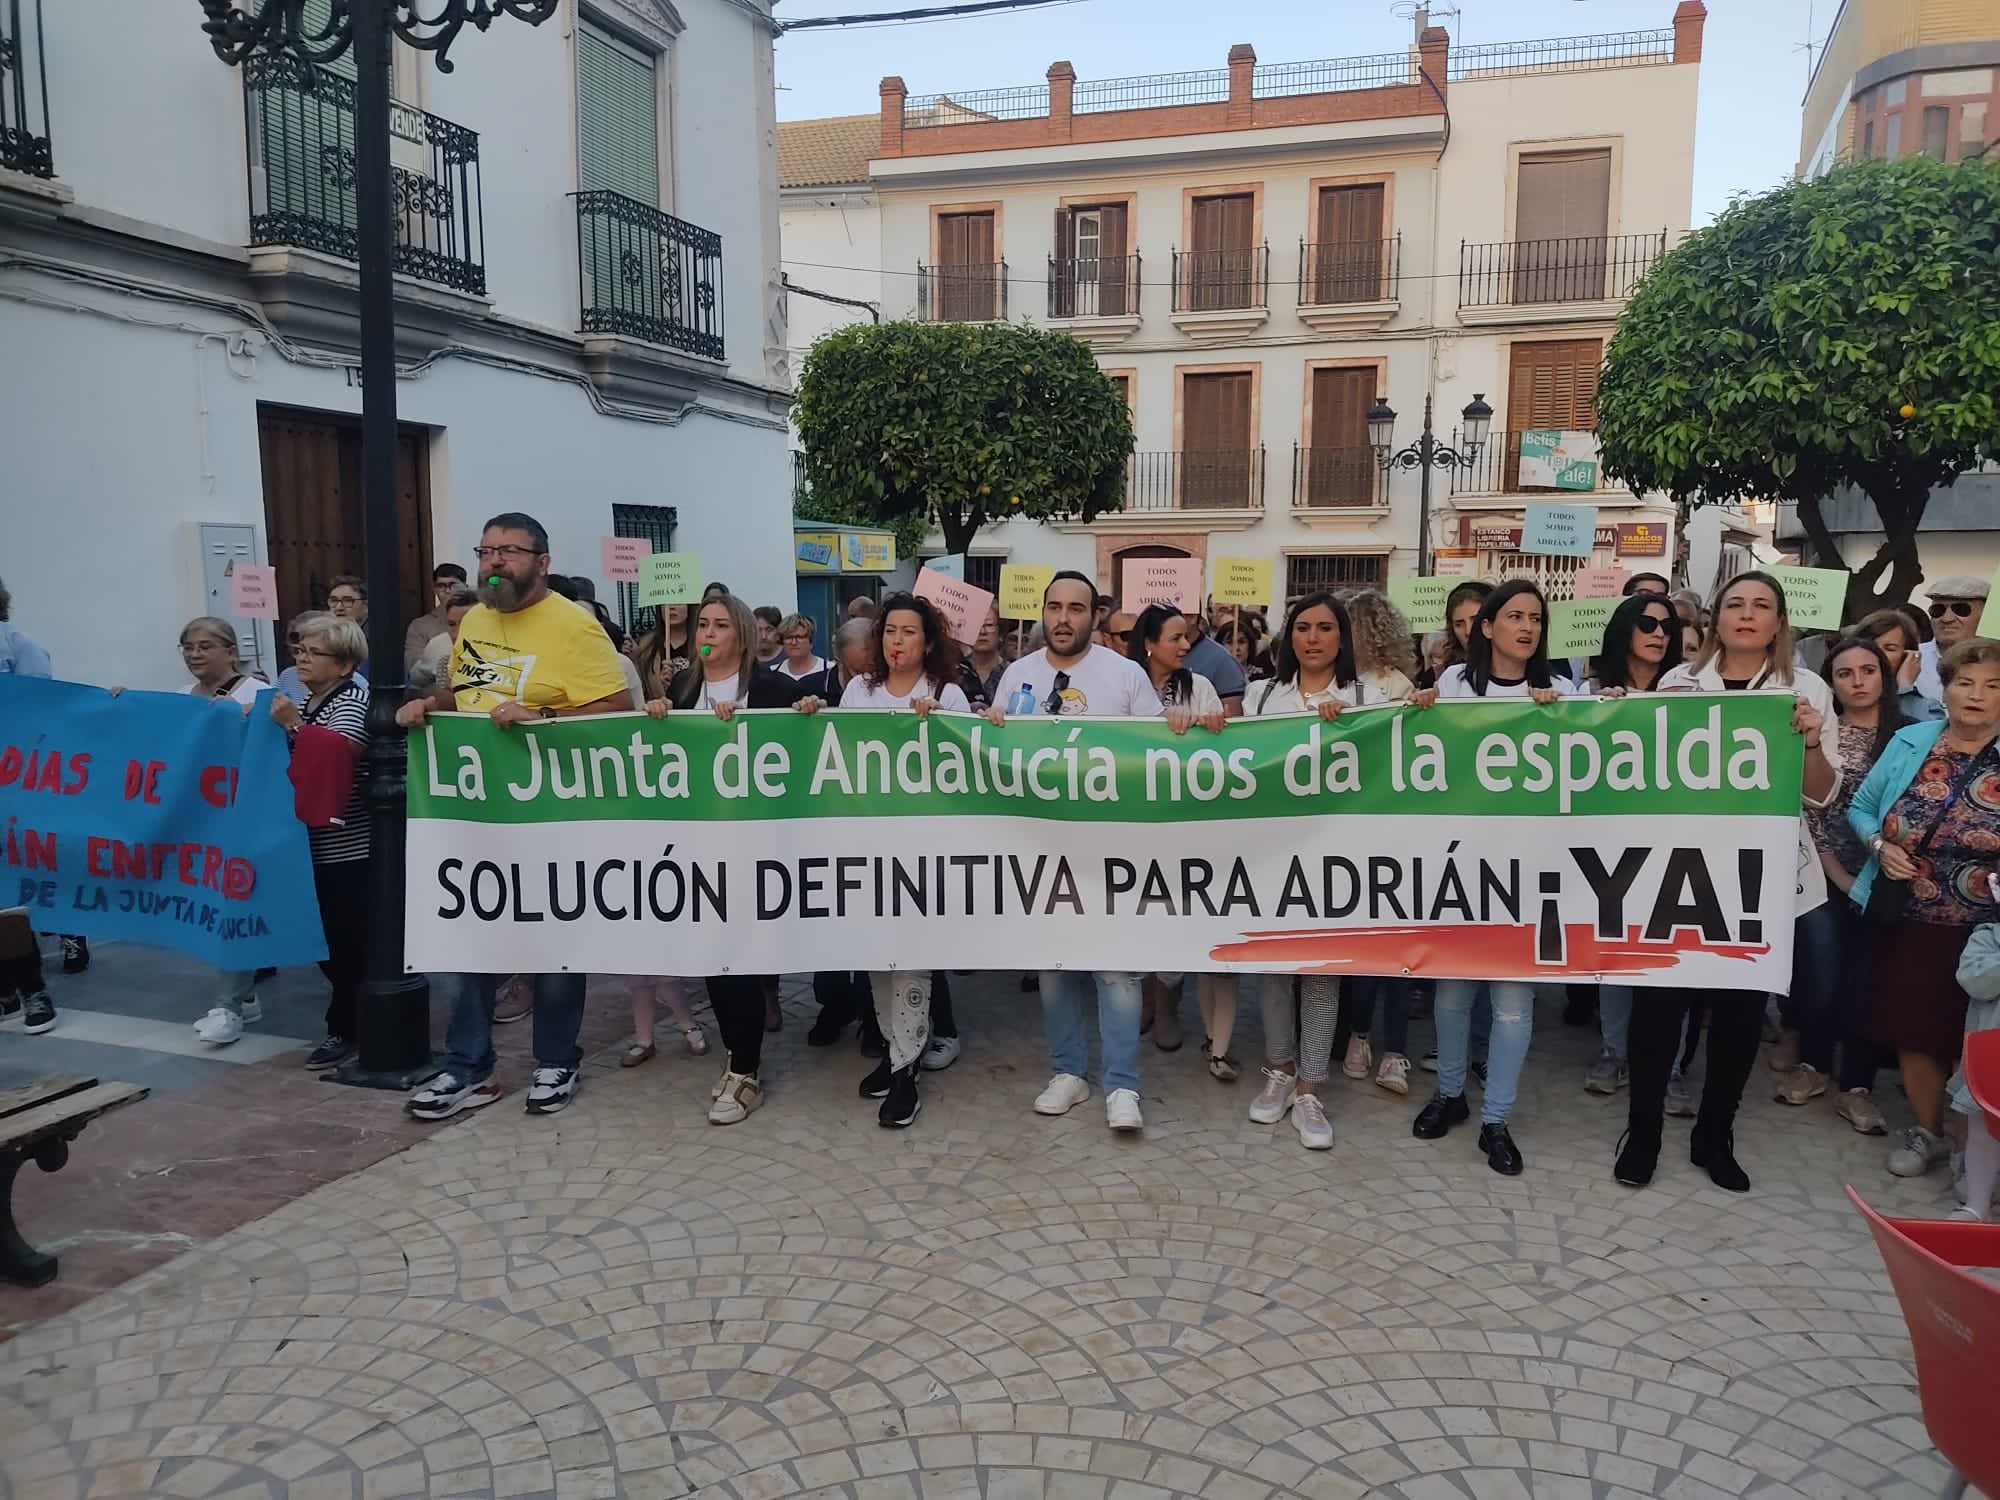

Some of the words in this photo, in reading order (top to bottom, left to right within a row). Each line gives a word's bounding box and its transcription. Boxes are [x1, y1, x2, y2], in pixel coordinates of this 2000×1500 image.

[1525, 432, 1556, 448] Betis
[1564, 467, 1592, 485] alé!
[1548, 512, 1576, 521] TODOS
[1545, 523, 1575, 532] SOMOS
[1595, 530, 1614, 543] MA
[1622, 535, 1663, 543] TABACOS
[1477, 541, 1516, 549] PAPELERIA
[655, 561, 681, 569] TODOS
[1147, 567, 1177, 576] TODOS
[654, 573, 681, 581] SOMOS
[1783, 576, 1819, 586] TODOS
[1146, 580, 1177, 588] SOMOS
[941, 584, 969, 601] TODOS
[1414, 585, 1447, 594] TODOS
[1785, 589, 1817, 600] OMOS
[935, 597, 965, 614] SOMOS
[1412, 599, 1447, 607] SOMOS
[1573, 608, 1607, 617] TODOS
[1571, 621, 1607, 631] SOMOS
[425, 725, 486, 801] La
[507, 726, 690, 802] Junta
[712, 721, 790, 798] de
[810, 720, 1119, 802] Andalucía
[1145, 744, 1257, 802] nos
[1283, 724, 1362, 797] da
[1391, 714, 1448, 793] la
[1475, 705, 1771, 814] espalda
[0, 733, 92, 796] DÍAS
[124, 760, 167, 804] DE
[20, 877, 57, 908] DE
[72, 884, 109, 913] LA
[119, 889, 195, 925] JUNTA
[437, 844, 728, 923] SOLUCIÓN
[755, 854, 1085, 920] DEFINITIVA
[1104, 858, 1261, 918] PARA
[1275, 840, 1521, 923] ADRIÁN
[1538, 847, 1764, 963] ¡YA!
